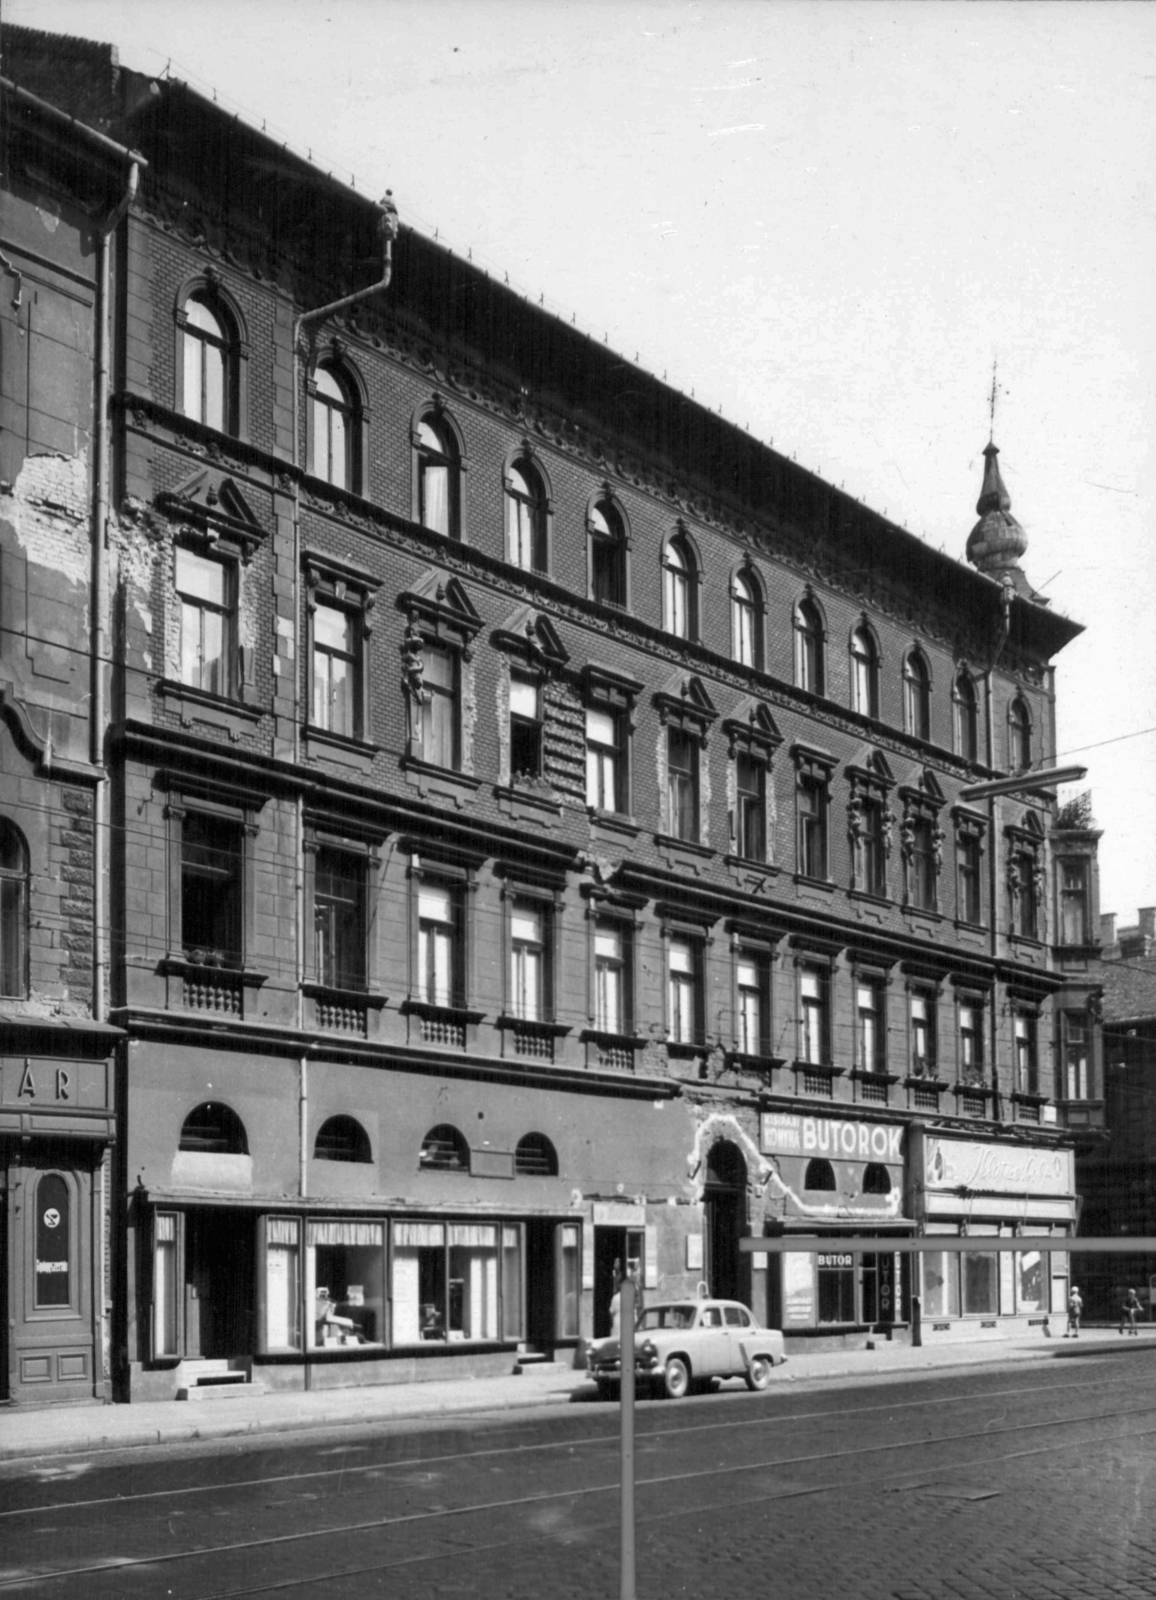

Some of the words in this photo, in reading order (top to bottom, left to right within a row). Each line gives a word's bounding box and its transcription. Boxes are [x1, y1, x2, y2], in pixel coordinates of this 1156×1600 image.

[802, 1117, 903, 1158] BUTOROK
[818, 1254, 852, 1266] BUTOR
[881, 1252, 890, 1311] UTOR
